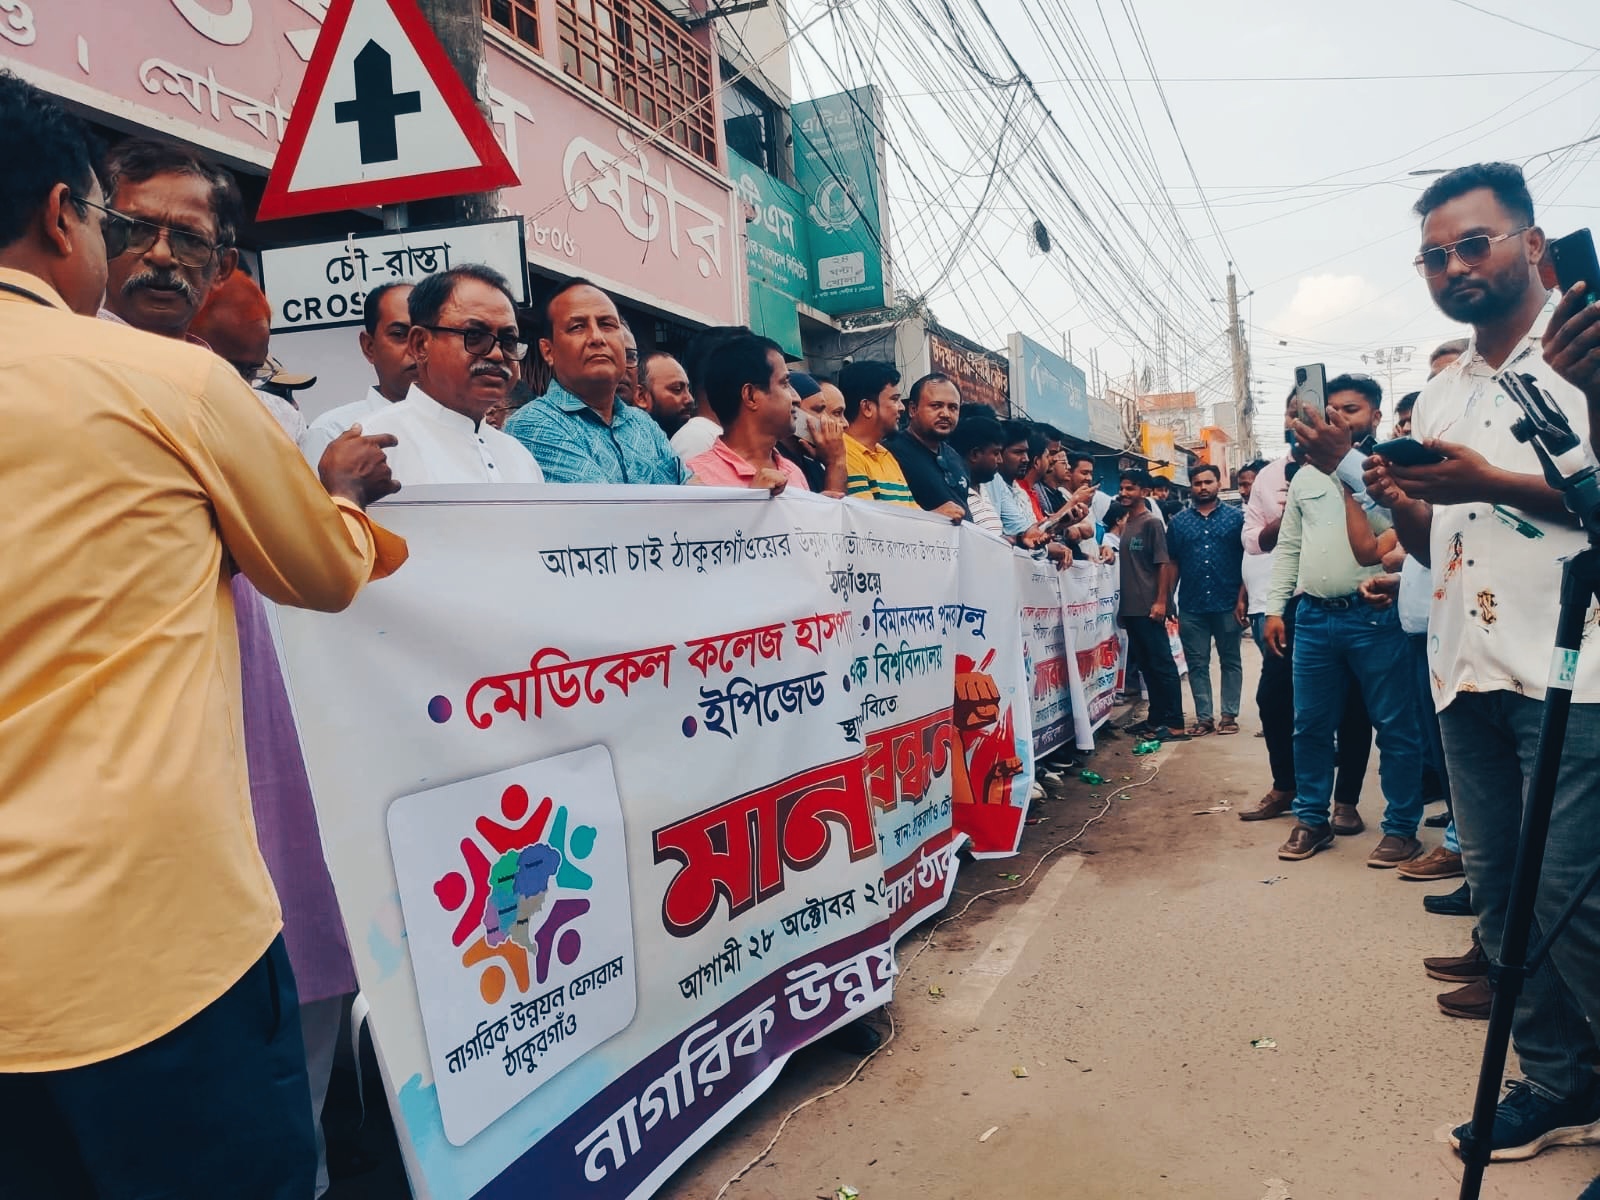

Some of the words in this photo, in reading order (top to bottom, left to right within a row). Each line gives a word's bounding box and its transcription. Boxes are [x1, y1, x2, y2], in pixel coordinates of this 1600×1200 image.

[139, 57, 292, 144] মোবা
[562, 127, 727, 279] স্টোর
[282, 292, 367, 323] CROS
[539, 544, 618, 578] আমরা
[625, 534, 664, 573] চাই
[670, 528, 791, 575] ঠাকুরগাঁওয়ের
[465, 644, 677, 730] মেডিকেল
[684, 622, 787, 679] কলেজ
[791, 610, 853, 655] হাসপা
[872, 597, 935, 639] বিমানবন্দর
[698, 671, 828, 739] ইপিজেড
[678, 937, 742, 1000] আগামী
[749, 929, 775, 960] ২৮
[780, 888, 856, 938] অক্টোবর
[863, 876, 886, 906] ২০
[446, 1015, 509, 1074] নাগরিক
[510, 986, 565, 1030] উন্নয়ন
[569, 955, 624, 1000] ফোরাম
[502, 1011, 577, 1077] ঠাকুরগাঁও
[575, 995, 776, 1182] নাগরিক
